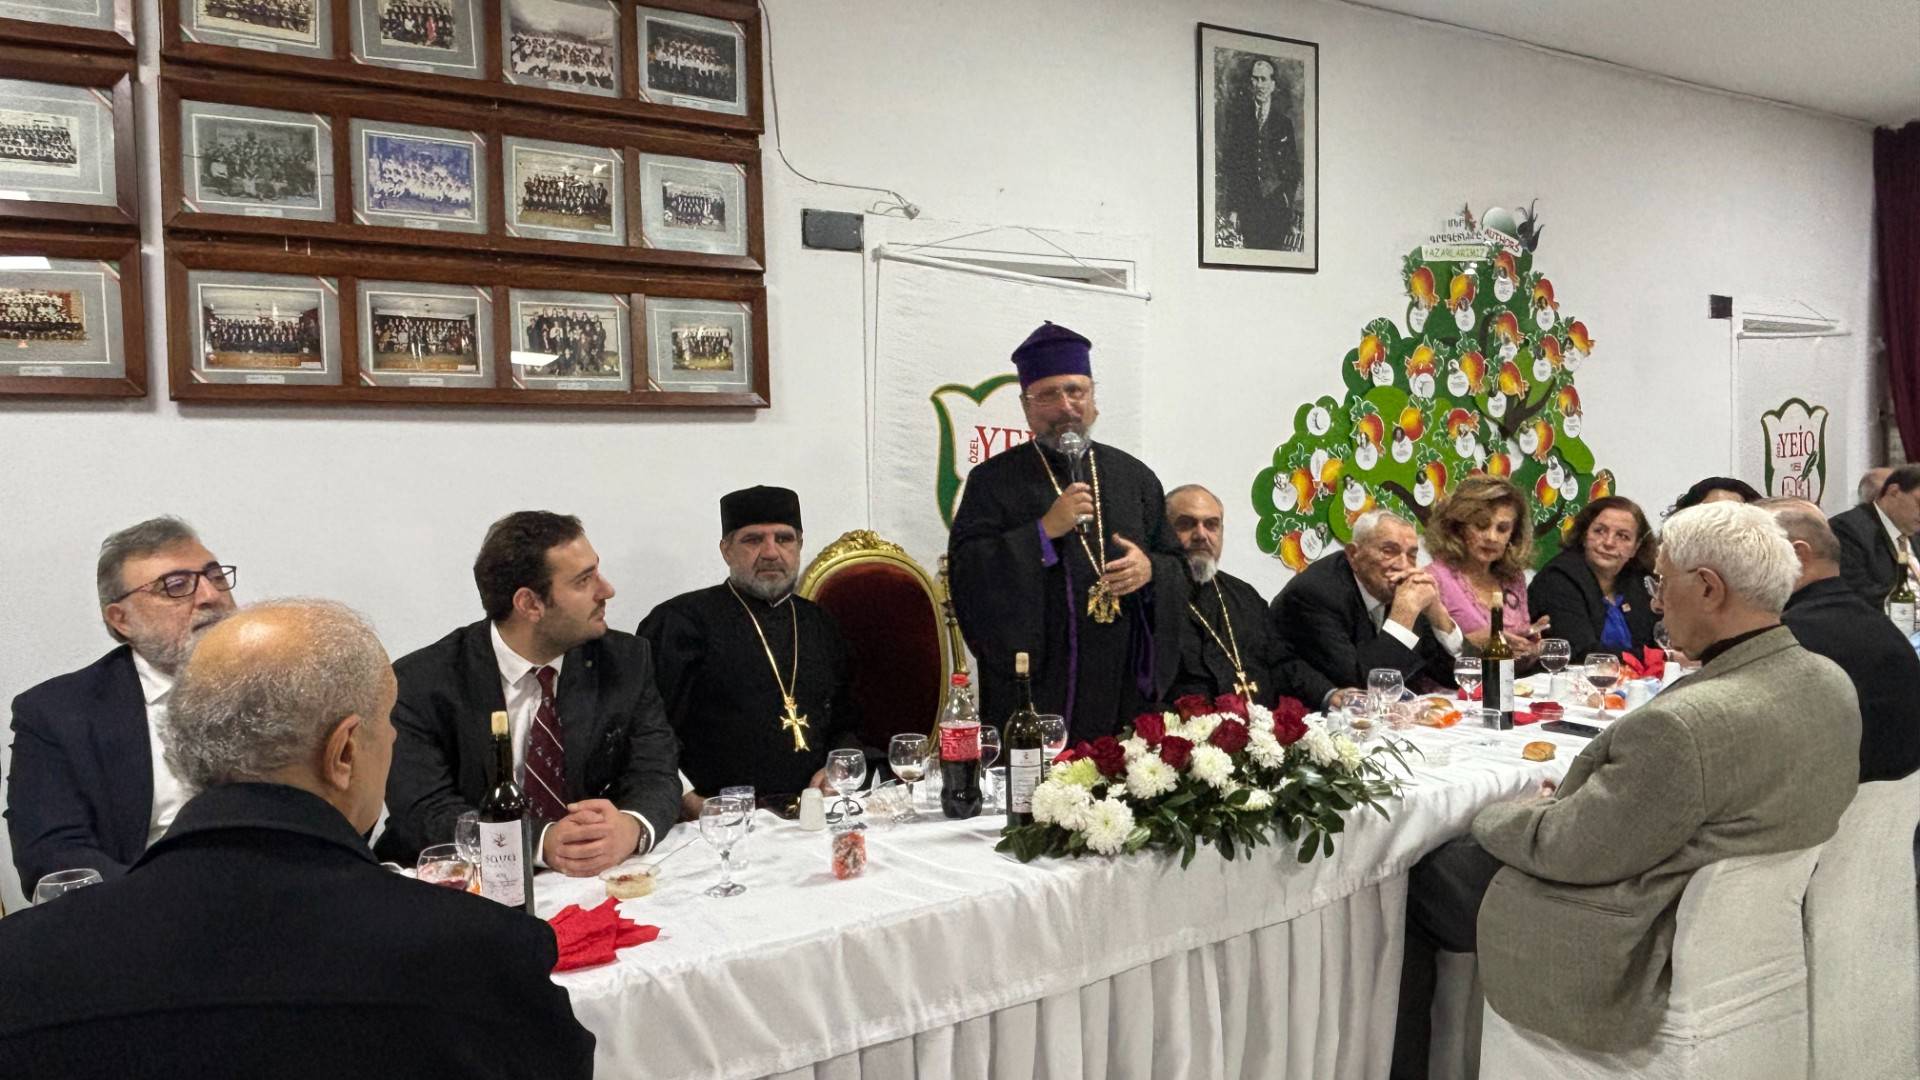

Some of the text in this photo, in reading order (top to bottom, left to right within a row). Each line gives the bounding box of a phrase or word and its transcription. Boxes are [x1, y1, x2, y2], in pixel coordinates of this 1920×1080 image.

[1484, 228, 1520, 253] AUTHORS
[967, 436, 979, 464] ÖZEL
[975, 425, 1036, 462] YE
